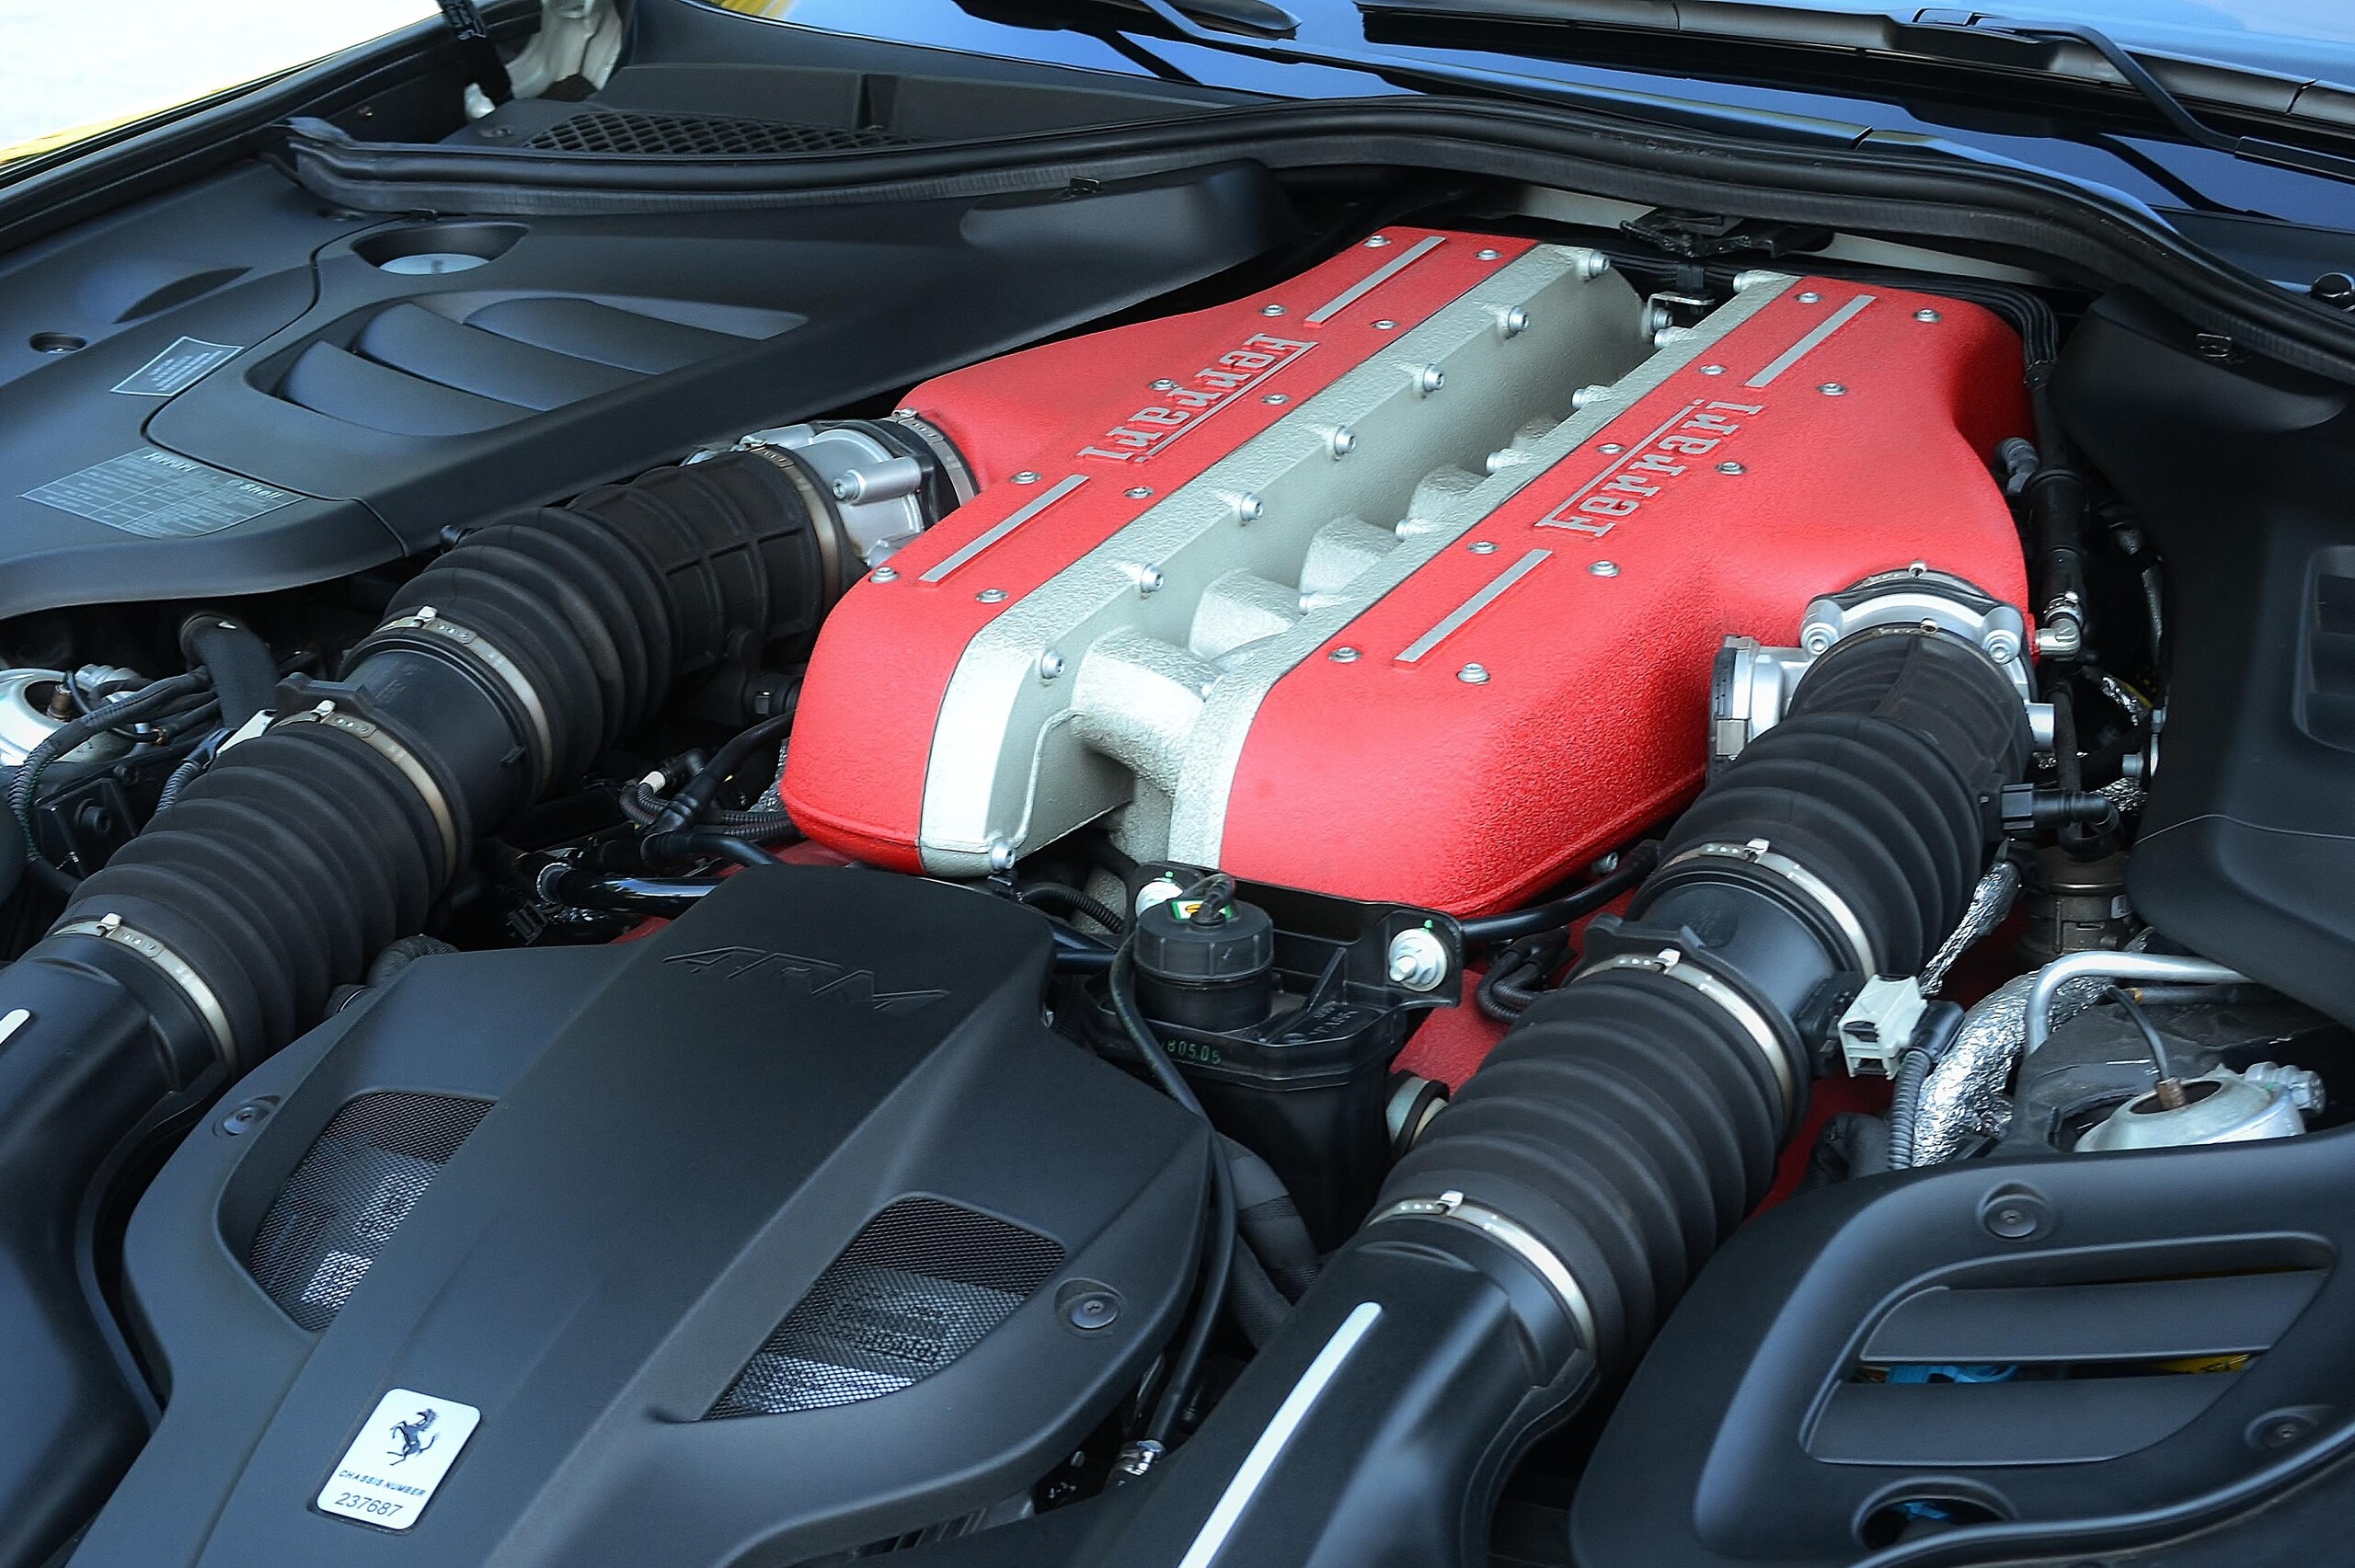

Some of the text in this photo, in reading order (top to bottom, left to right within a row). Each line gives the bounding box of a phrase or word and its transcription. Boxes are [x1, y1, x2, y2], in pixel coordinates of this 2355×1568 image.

[1076, 332, 1319, 464] Ferrari
[1534, 398, 1764, 538] Ferrari
[240, 483, 284, 499] Shell
[339, 1470, 427, 1496] CHASSIS NUMBER
[334, 1492, 403, 1516] 237687
